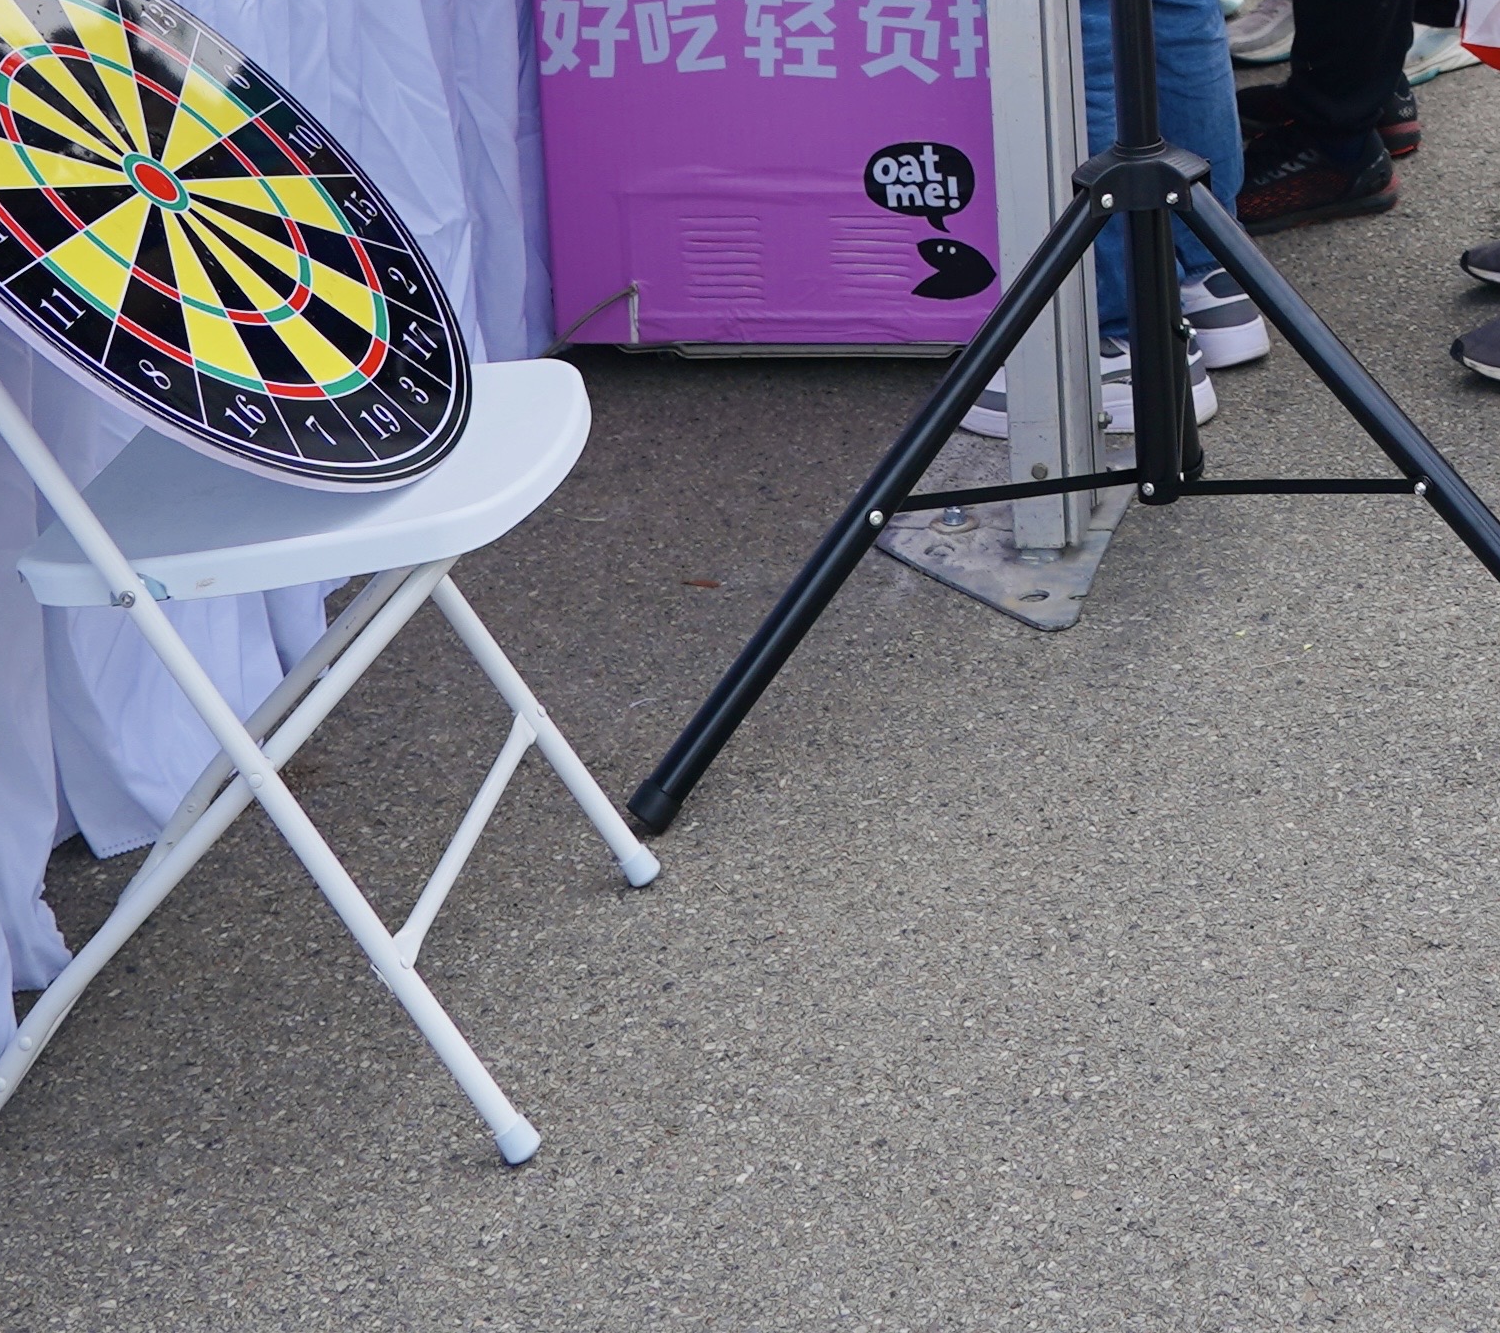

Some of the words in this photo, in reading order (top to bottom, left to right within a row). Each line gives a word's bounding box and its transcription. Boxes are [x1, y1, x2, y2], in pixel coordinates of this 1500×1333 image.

[223, 64, 252, 91] 6
[286, 124, 324, 159] 10
[872, 145, 943, 184] oat
[342, 189, 378, 228] 15
[886, 174, 961, 209] me!
[391, 266, 419, 296] 2
[39, 287, 87, 331] 11
[402, 322, 439, 361] 17
[138, 358, 173, 391] 8
[400, 376, 430, 405] 3
[223, 392, 269, 437] 16
[304, 416, 339, 447] 7
[359, 402, 402, 441] 19
